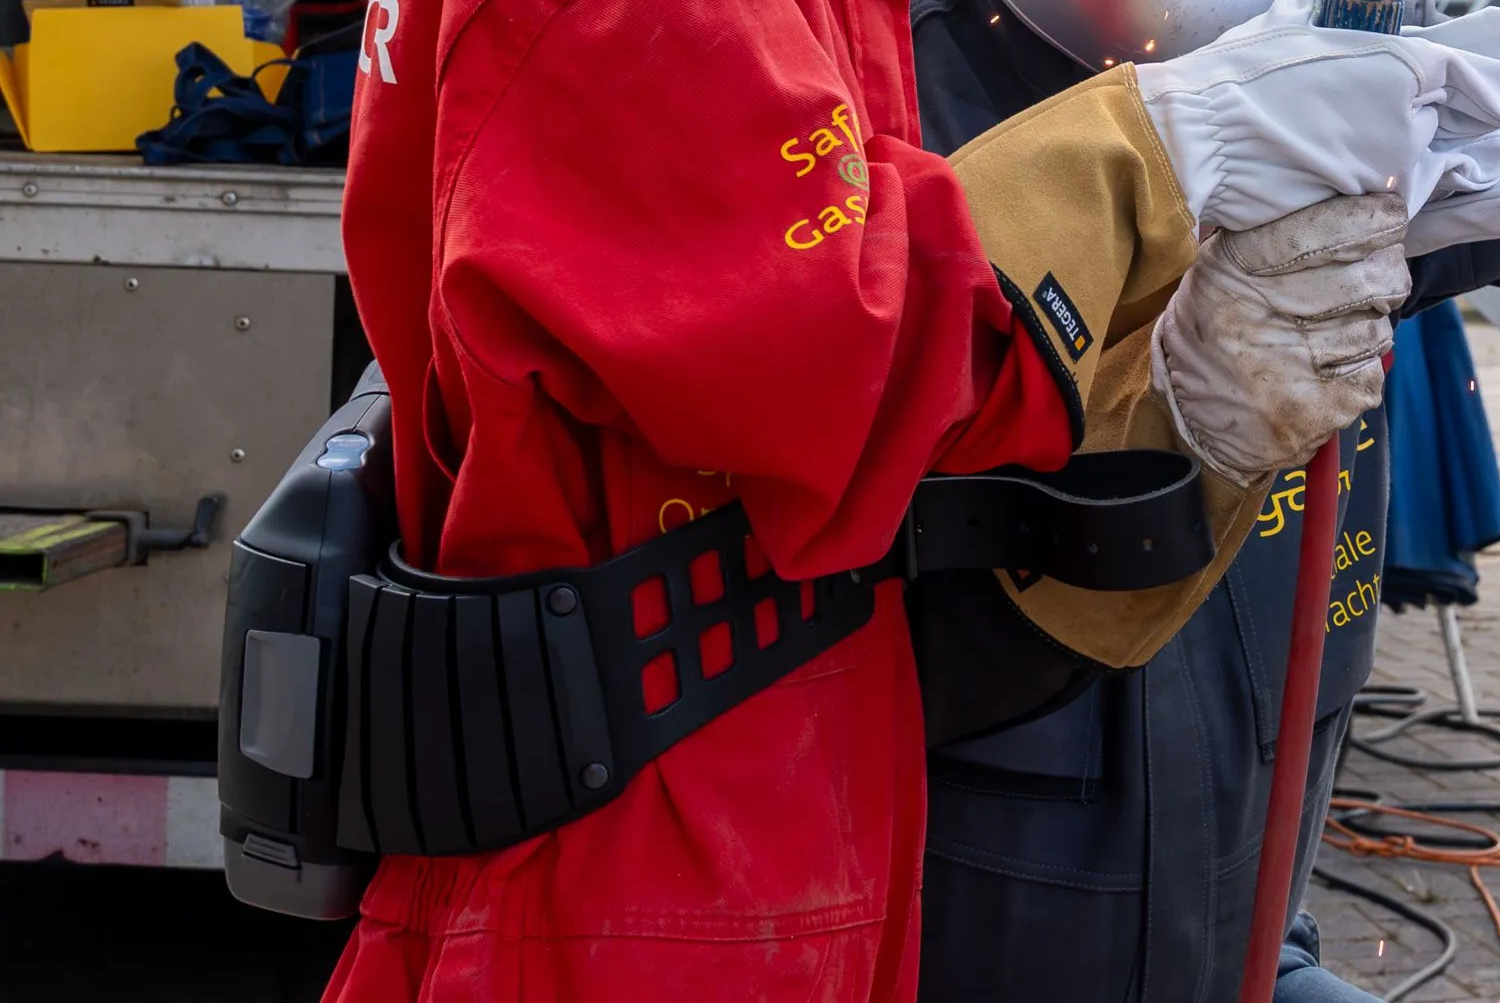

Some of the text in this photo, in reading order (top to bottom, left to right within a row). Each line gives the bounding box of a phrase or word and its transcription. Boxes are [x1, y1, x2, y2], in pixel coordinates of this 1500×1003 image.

[780, 104, 862, 178] Saf
[784, 195, 868, 250] Gas
[1046, 287, 1079, 341] TEGERA
